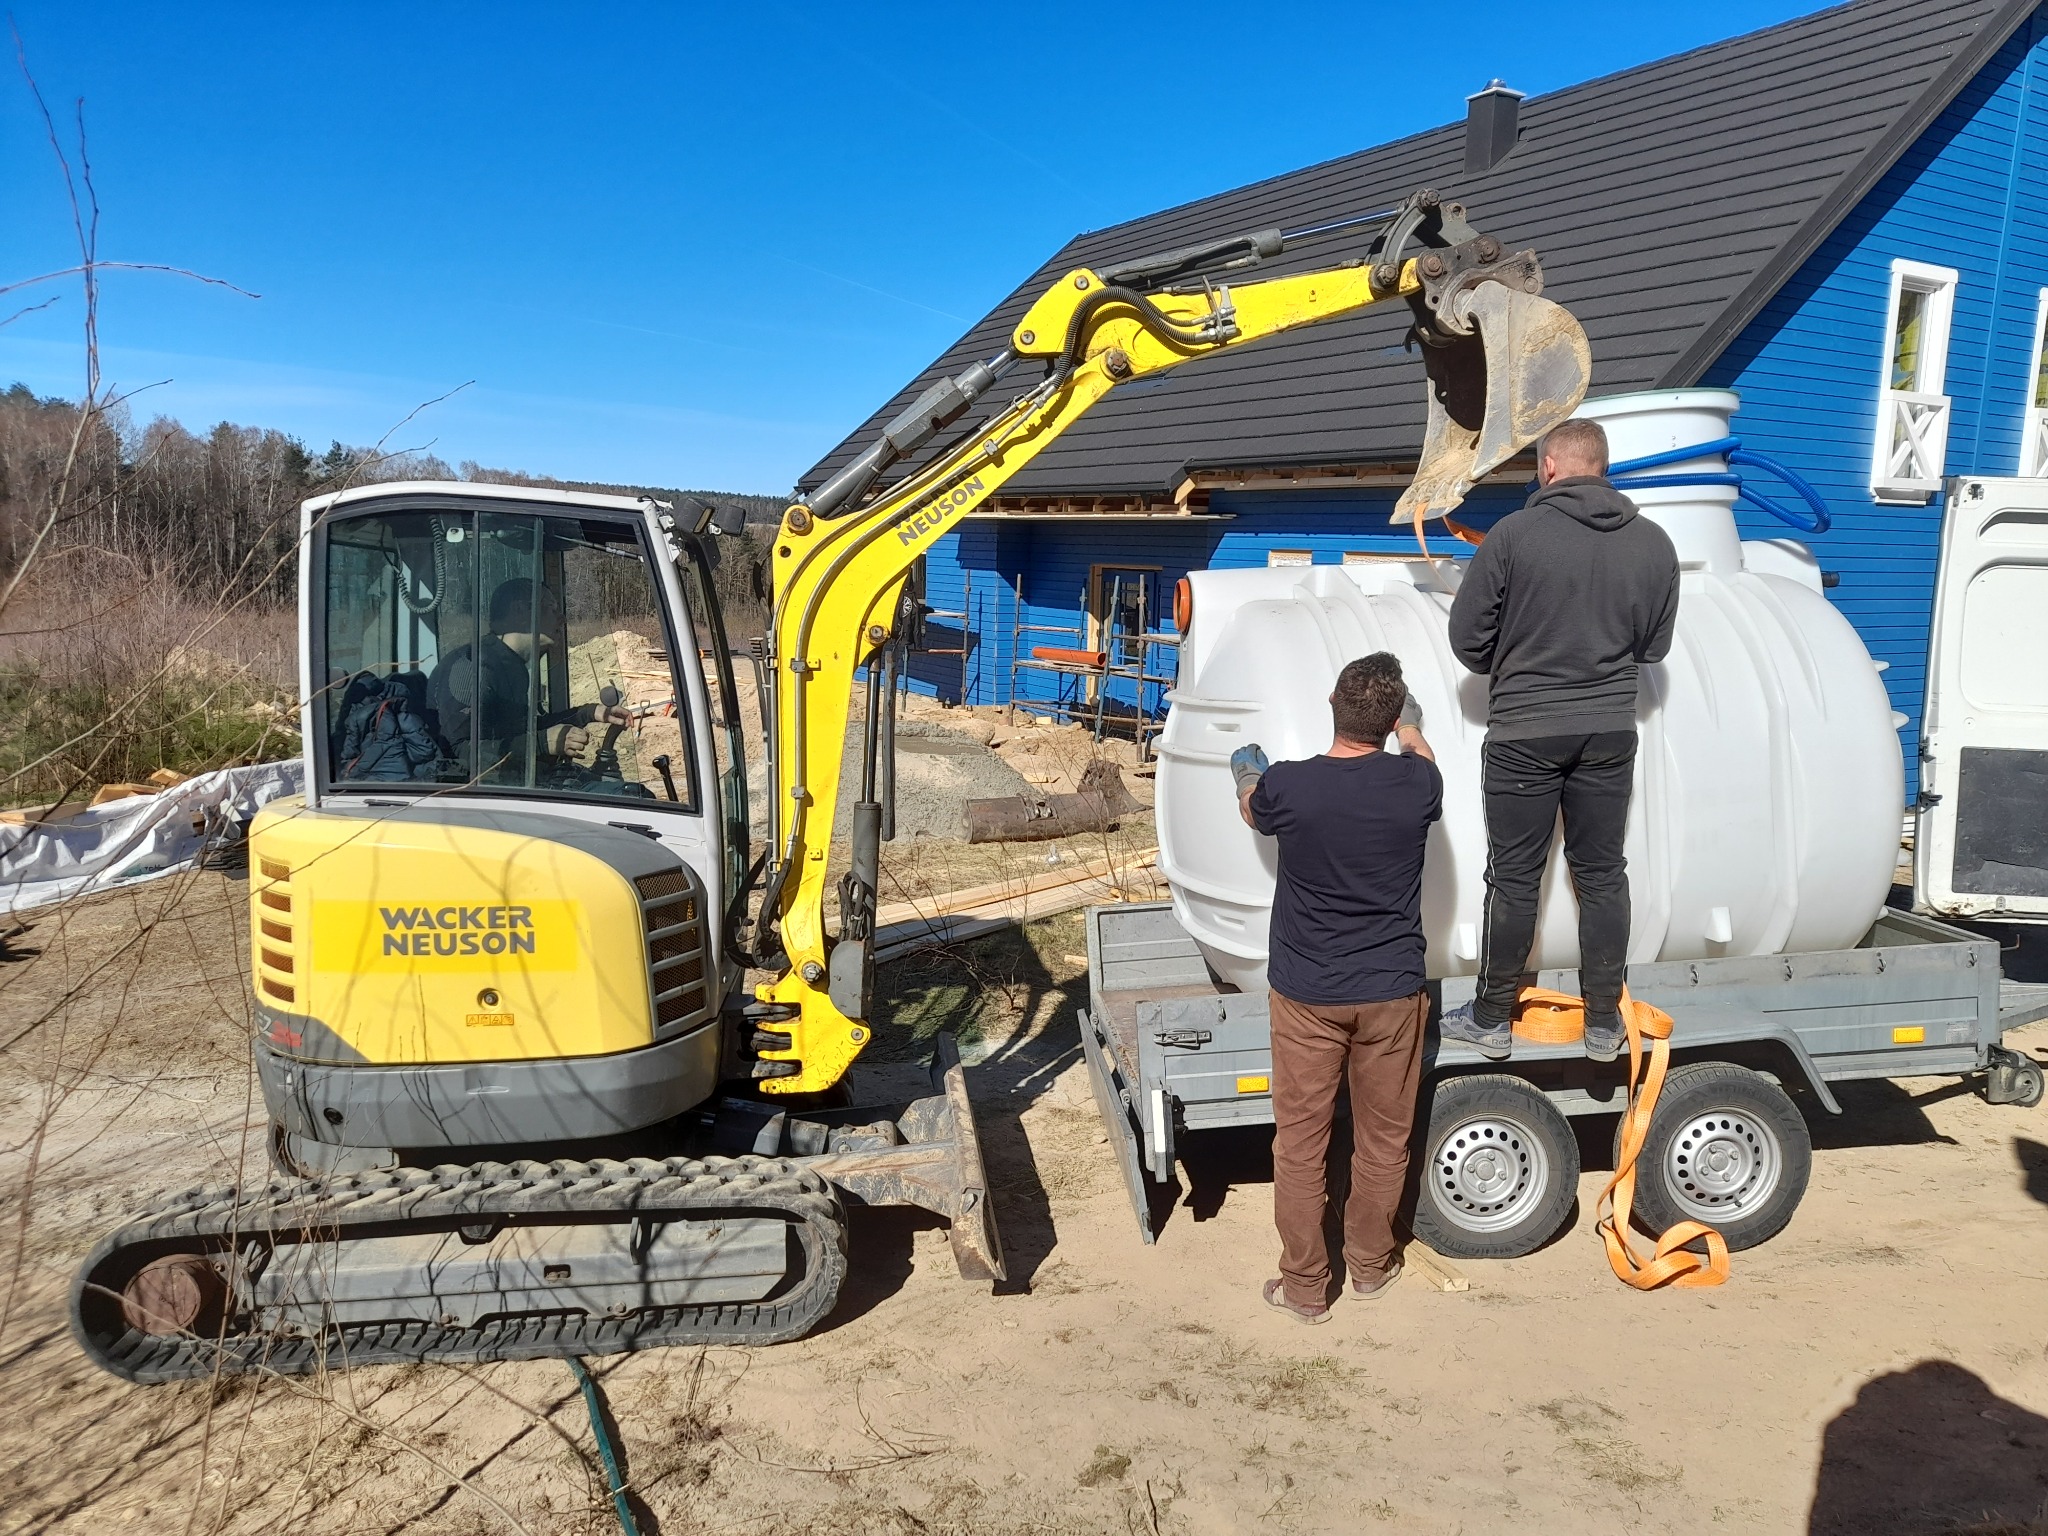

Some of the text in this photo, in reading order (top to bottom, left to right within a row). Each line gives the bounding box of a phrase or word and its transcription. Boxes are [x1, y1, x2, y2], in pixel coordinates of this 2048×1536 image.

[897, 476, 985, 546] NEUSON
[379, 906, 534, 930] WACKER
[383, 931, 535, 956] NEUSON
